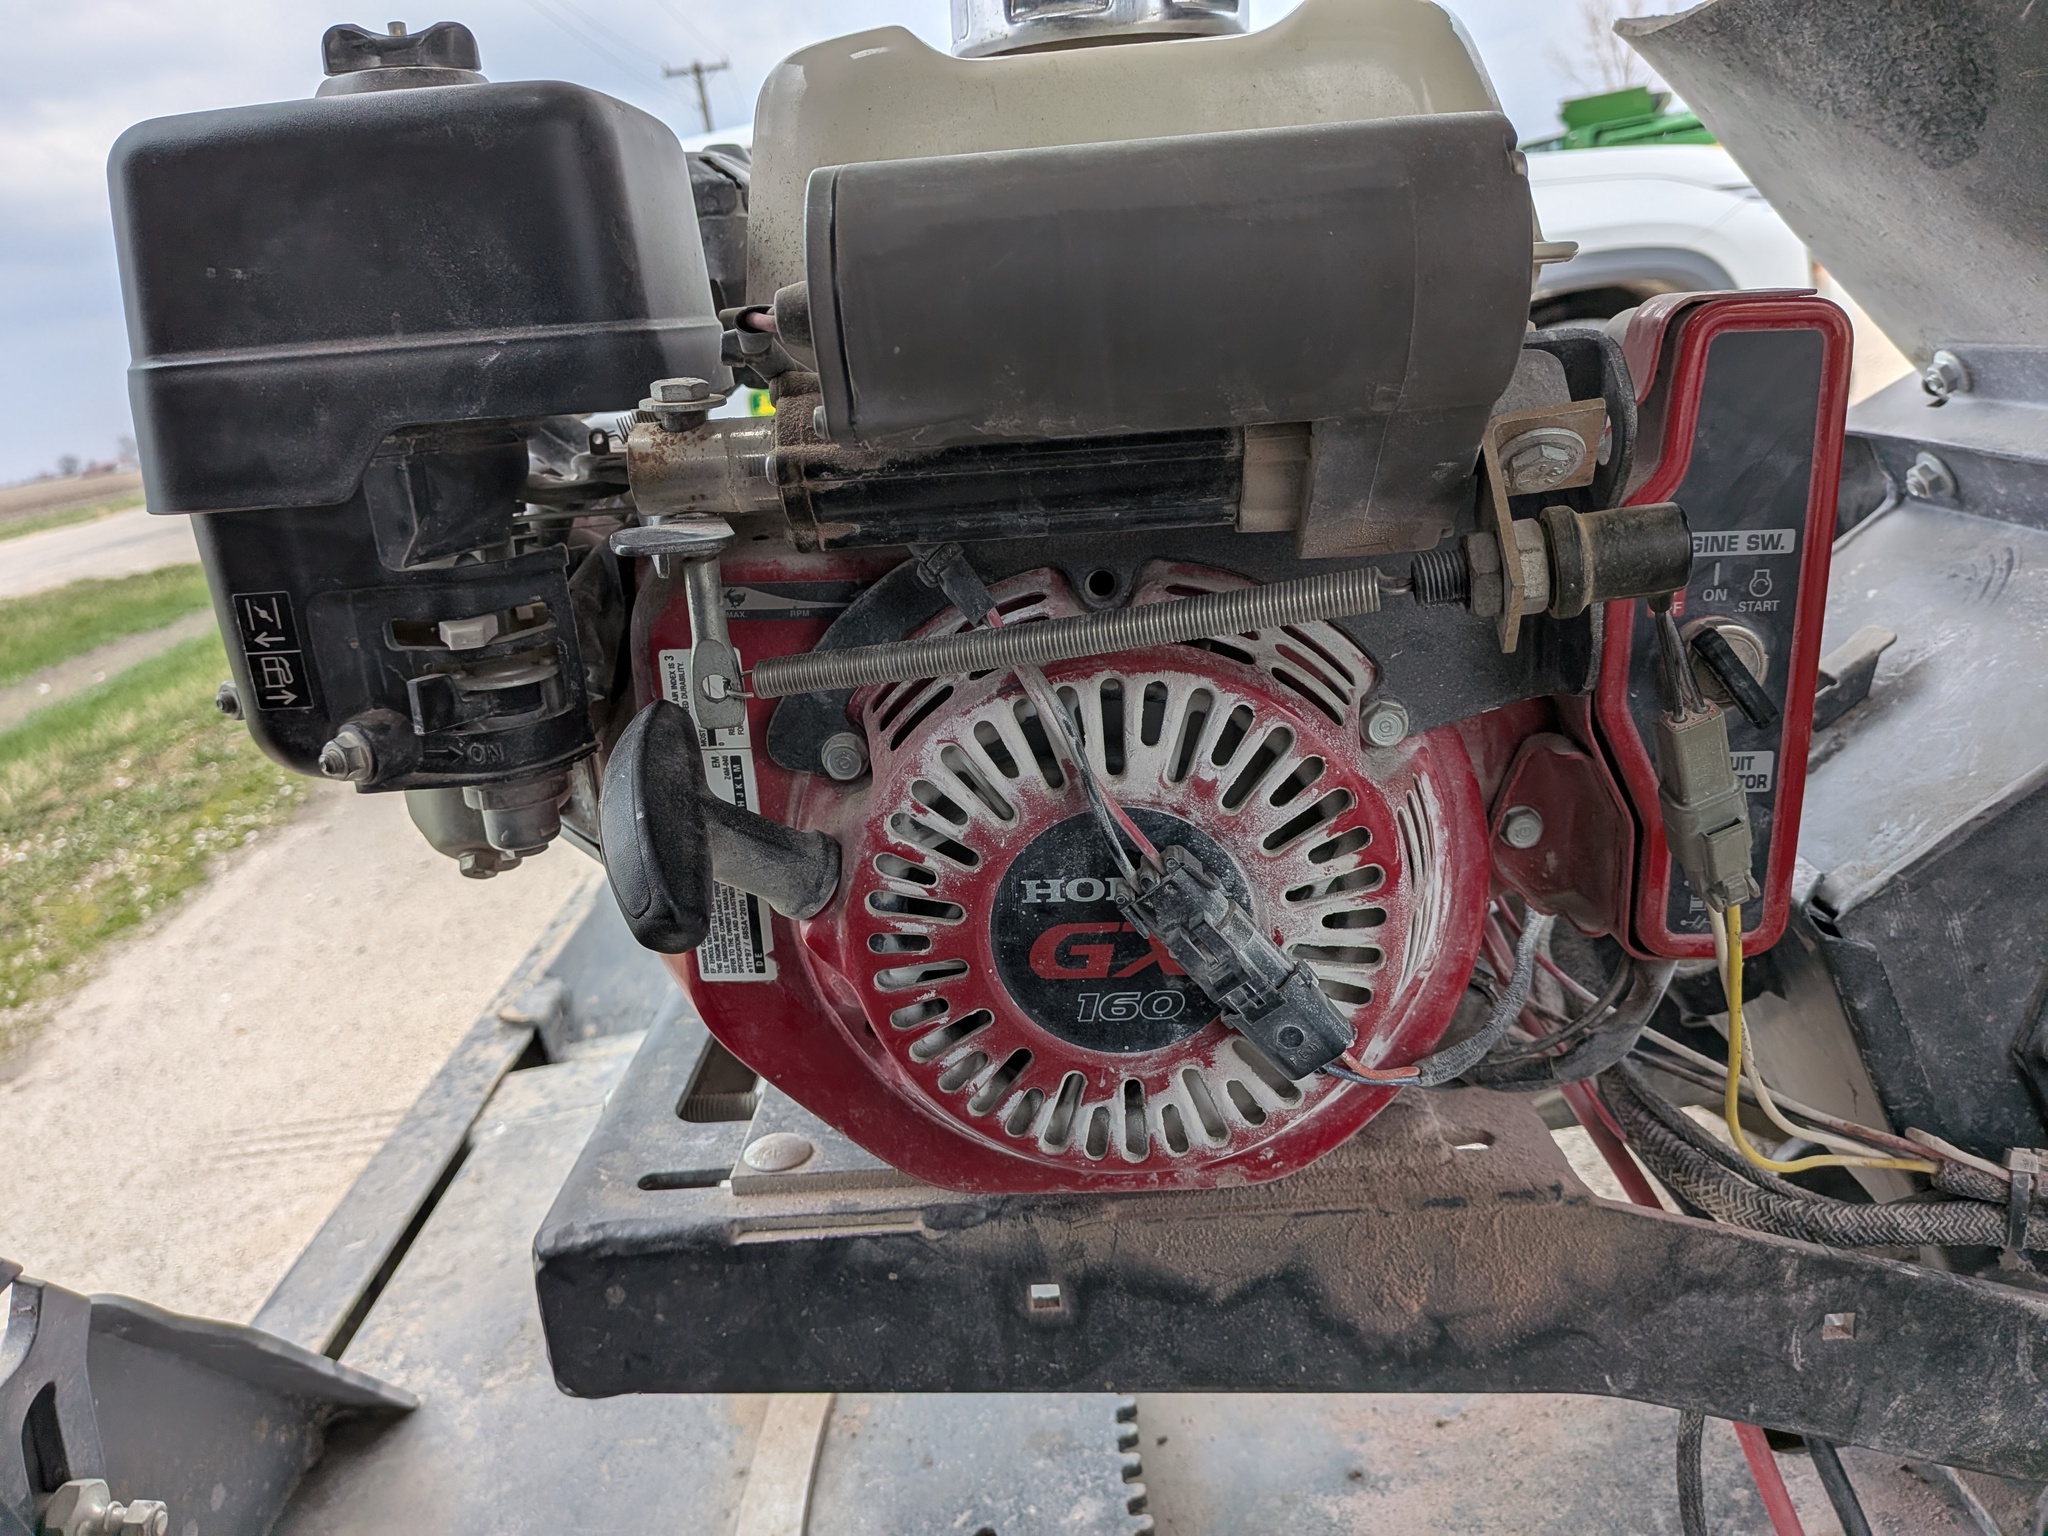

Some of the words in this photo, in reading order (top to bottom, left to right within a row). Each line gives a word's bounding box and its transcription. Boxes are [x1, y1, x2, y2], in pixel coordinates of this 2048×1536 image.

[1746, 533, 1785, 551] SW.
[1702, 588, 1728, 602] ON
[677, 663, 687, 699] DURABILITY.
[699, 728, 707, 747] MOST
[468, 741, 502, 763] ON
[711, 757, 720, 768] EM
[713, 881, 721, 897] PERIO
[716, 899, 725, 932] COMPLIANCE
[720, 934, 729, 962] EMISSIONS
[734, 933, 744, 973] SPECIFICATIONS
[1028, 921, 1190, 979] GX
[1076, 990, 1186, 1023] 160
